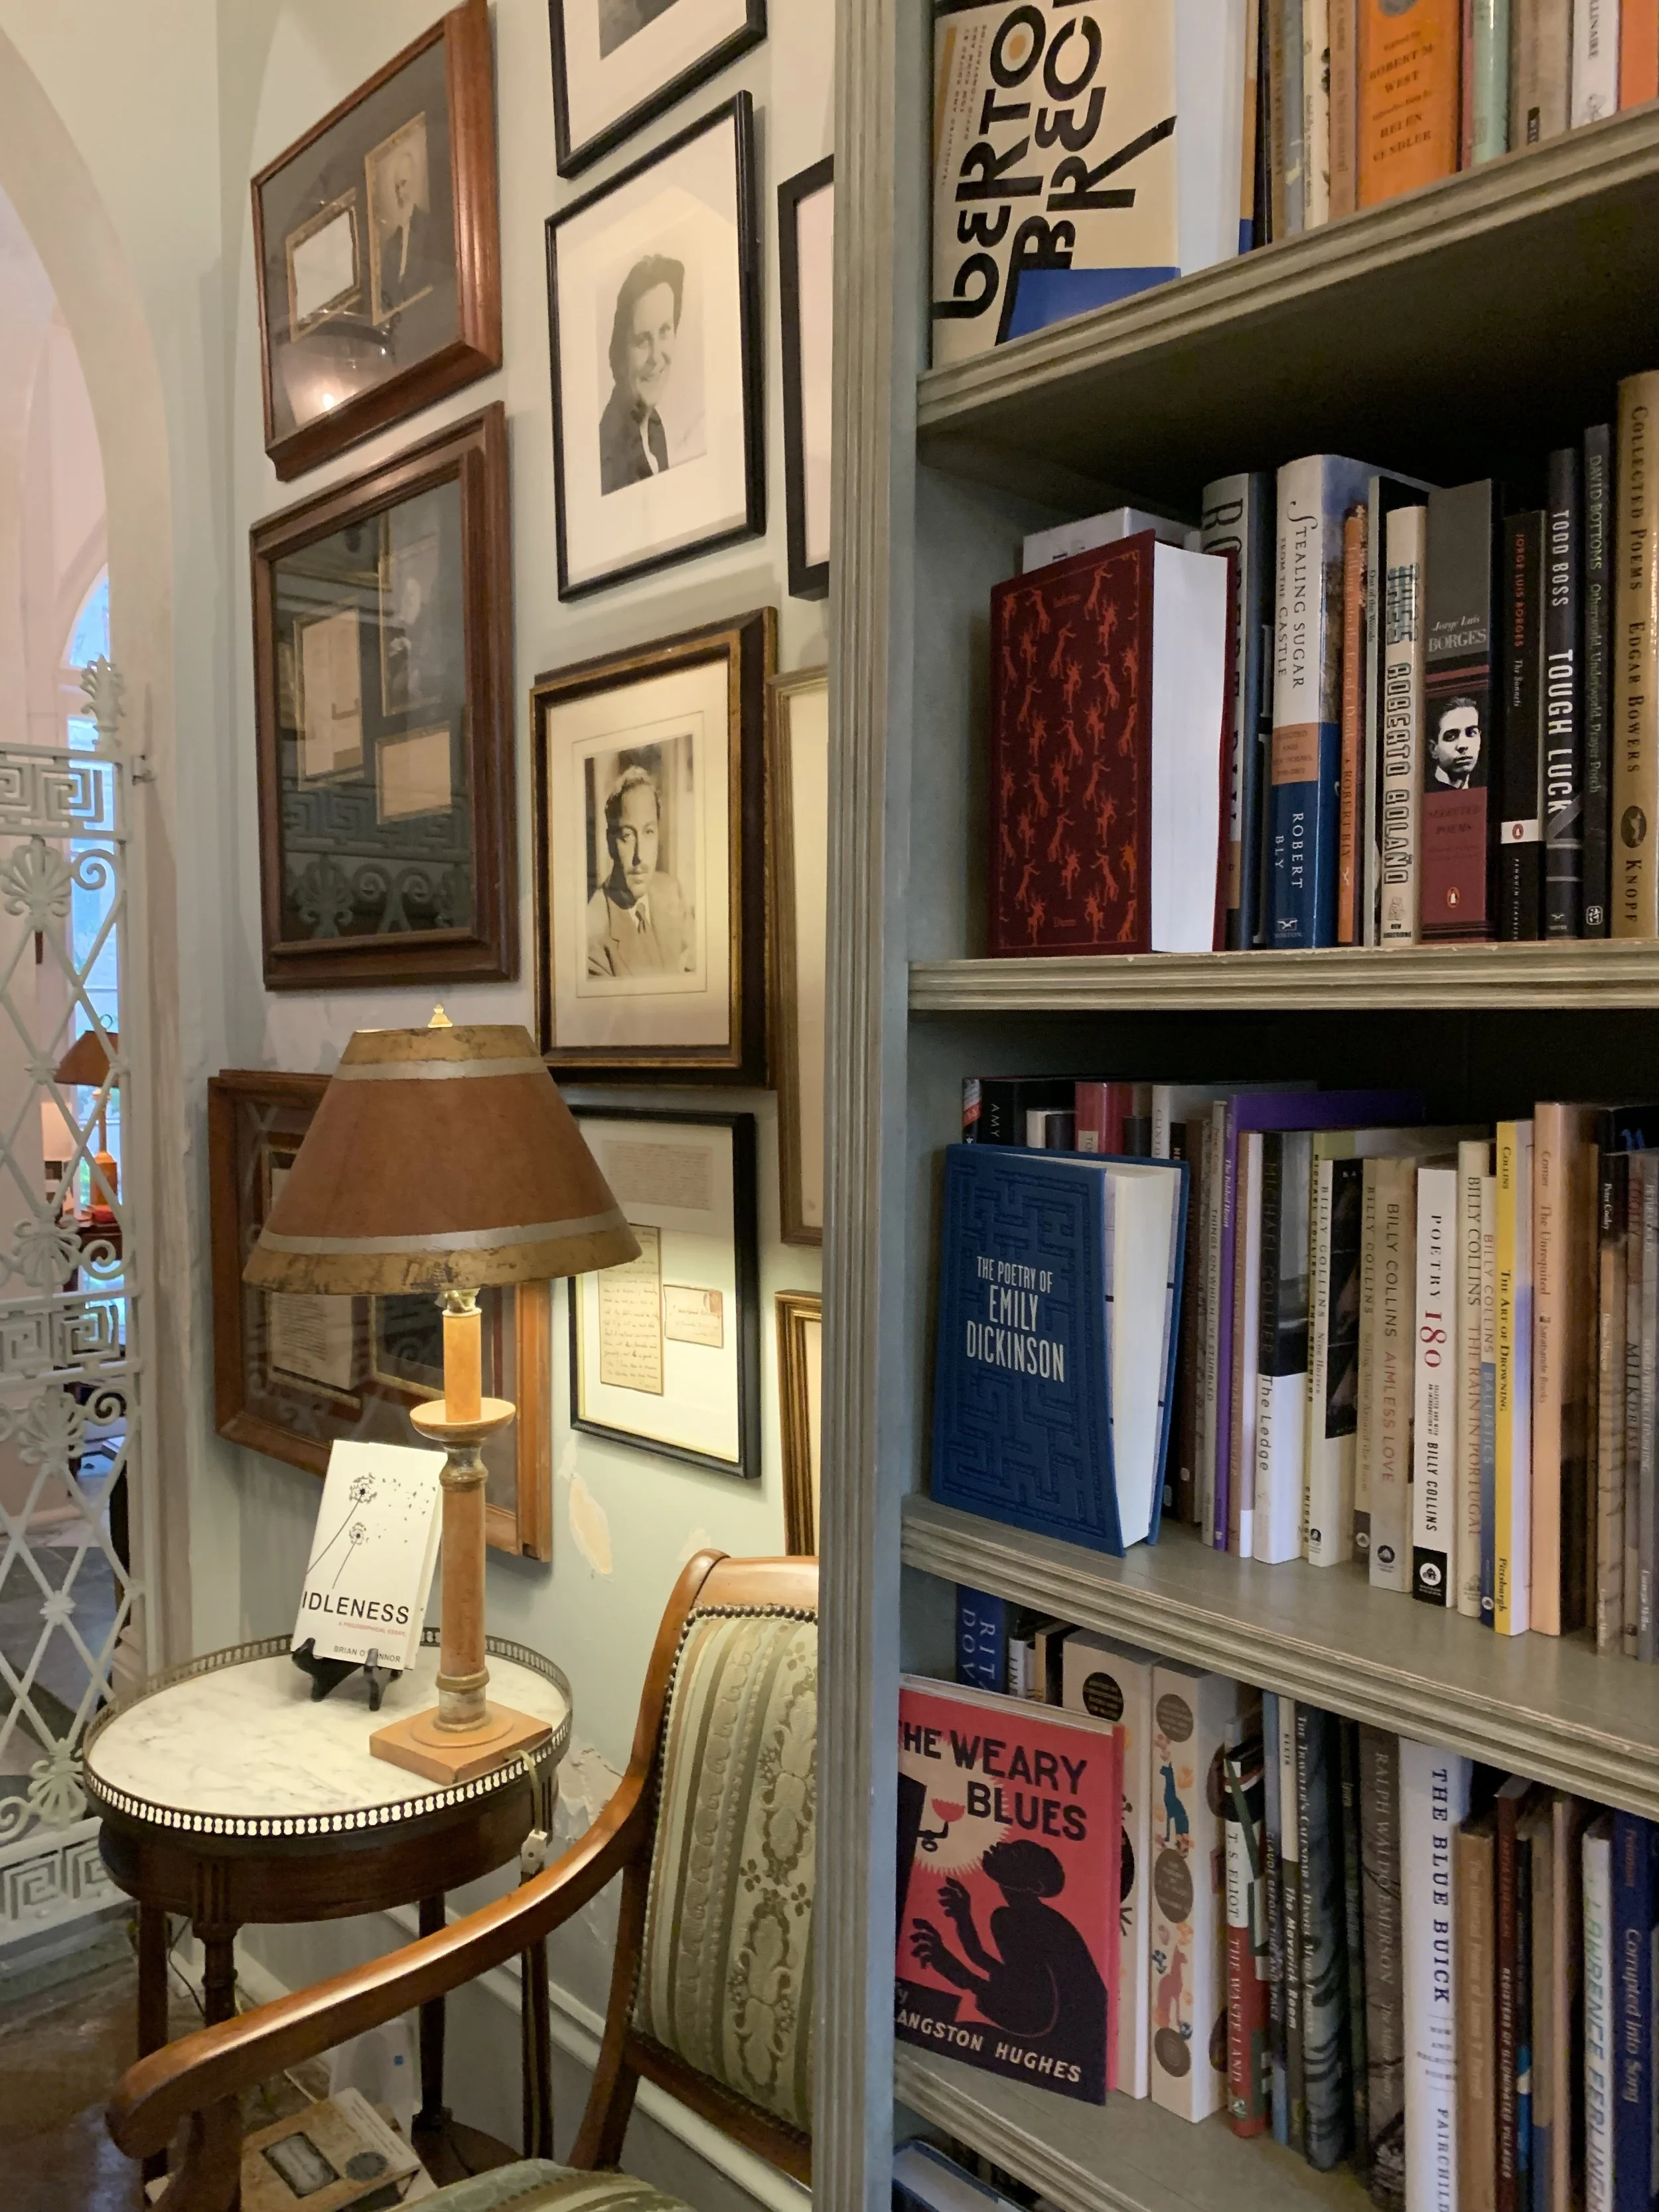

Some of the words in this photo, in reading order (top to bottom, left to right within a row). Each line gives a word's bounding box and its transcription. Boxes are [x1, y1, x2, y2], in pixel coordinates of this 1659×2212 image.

[995, 0, 1179, 346] BREC
[1589, 454, 1603, 500] DAVID
[1630, 405, 1650, 519] COLLECTED
[1514, 533, 1524, 569] JORGE
[1552, 510, 1570, 555] TODD
[1589, 504, 1603, 570] BOTTOMS
[1288, 501, 1318, 614] STEALING
[1628, 529, 1648, 591] POEMS
[1514, 573, 1524, 598] LUIS
[1551, 562, 1570, 607] BOSS
[1277, 606, 1288, 678] CASTLE
[1368, 614, 1376, 643] Woods
[1427, 627, 1487, 652] BORGES
[1433, 620, 1458, 632] Jorge
[1461, 615, 1480, 626] Luis
[1514, 601, 1524, 647] BORGES
[1293, 623, 1306, 690] SUGAR
[1513, 659, 1523, 674] The
[1626, 621, 1646, 685] EDGAR
[1513, 676, 1523, 707] Sonnets
[1548, 648, 1574, 735] TOUGH
[1386, 662, 1411, 777] ROBERTO
[1626, 695, 1646, 773] BOWERS
[1340, 771, 1352, 827] ROBERT
[1547, 749, 1573, 815] LUCK
[1274, 835, 1285, 869] BLY
[1291, 812, 1305, 889] ROBERT
[1340, 834, 1352, 859] BLY
[1384, 788, 1413, 885] BOLAÑO
[1624, 859, 1644, 922] KNOPF
[990, 1103, 1001, 1138] AMY
[1224, 1159, 1232, 1175] The
[1501, 1146, 1512, 1190] COLLINS
[1262, 1163, 1277, 1251] MICHAEL
[1320, 1185, 1329, 1235] BILLY
[1366, 1186, 1376, 1232] BILLY
[1467, 1176, 1481, 1222] BILLY
[1539, 1204, 1552, 1226] The
[1601, 1204, 1613, 1230] Cooley
[1602, 1183, 1614, 1203] Peter
[1386, 1203, 1400, 1252] BILLY
[976, 1256, 995, 1282] THE
[997, 1260, 1037, 1290] POETRY
[1039, 1270, 1054, 1293] OF
[1210, 1254, 1218, 1274] ON
[1364, 1241, 1375, 1315] COLLINS
[1429, 1215, 1443, 1305] POETRY
[1467, 1228, 1482, 1305] COLLINS
[1484, 1234, 1494, 1278] BILLY
[1537, 1231, 1552, 1295] Unrequited
[1317, 1244, 1329, 1318] COLLINS
[1384, 1260, 1399, 1337] COLLINS
[1500, 1269, 1512, 1293] THE
[989, 1284, 1039, 1332] EMILY
[1261, 1265, 1276, 1353] COLLIER
[1484, 1285, 1494, 1353] COLLINS
[1500, 1298, 1512, 1323] ART
[966, 1319, 1064, 1383] DICKINSON
[1419, 1309, 1448, 1368] 180
[1467, 1325, 1481, 1358] THE
[1500, 1326, 1511, 1341] OF
[1260, 1376, 1273, 1408] The
[1382, 1351, 1396, 1428] AIMLESS
[1467, 1367, 1481, 1412] RAIN
[1499, 1345, 1510, 1412] DROWNING
[1538, 1376, 1549, 1404] Books
[1467, 1417, 1481, 1430] IN
[1483, 1370, 1494, 1465] BALLISTICS
[1257, 1415, 1273, 1471] Ledge
[1382, 1436, 1396, 1483] LOVE
[1426, 1441, 1439, 1475] BILLY
[1425, 1480, 1438, 1531] COLLINS
[1467, 1442, 1481, 1539] PORTUGAL
[302, 1591, 409, 1625] IDLENESS
[1496, 1556, 1508, 1612] Pittsburgh
[334, 1645, 358, 1656] BRIAN
[359, 1649, 401, 1662] O'NNOR
[1297, 1716, 1309, 1736] THE
[899, 1720, 942, 1760] HE
[949, 1728, 1088, 1795] WEARY
[1375, 1753, 1390, 1816] RALPH
[1431, 1767, 1449, 1822] THE
[968, 1780, 1087, 1842] BLUES
[1227, 1832, 1239, 1844] T.
[1227, 1850, 1239, 1860] S.
[1265, 1832, 1276, 1876] CLAUDE
[1375, 1822, 1392, 1890] WALDO
[1228, 1868, 1240, 1919] ELIOT
[1432, 1834, 1449, 1907] BLUE
[1267, 1880, 1277, 1923] BEFORE
[1284, 1885, 1296, 1911] The
[1301, 1893, 1313, 1937] DANIEL
[1229, 1938, 1241, 1972] THE
[1286, 1915, 1299, 1983] Maverick
[1377, 1894, 1395, 1984] EMERSON
[1432, 1918, 1451, 2004] BUICK
[1585, 1897, 1605, 2060] LAWRENCE
[1621, 1927, 1642, 2018] Corrupted
[1229, 1977, 1241, 2031] WASTE
[1269, 1984, 1279, 2021] SPACE
[1287, 1990, 1297, 2029] Room
[896, 2009, 983, 2052] ANGSTON
[995, 2041, 1082, 2083] HUGHES
[1230, 2036, 1242, 2083] LAND
[1624, 2020, 1642, 2054] Into
[1623, 2058, 1642, 2103] Song
